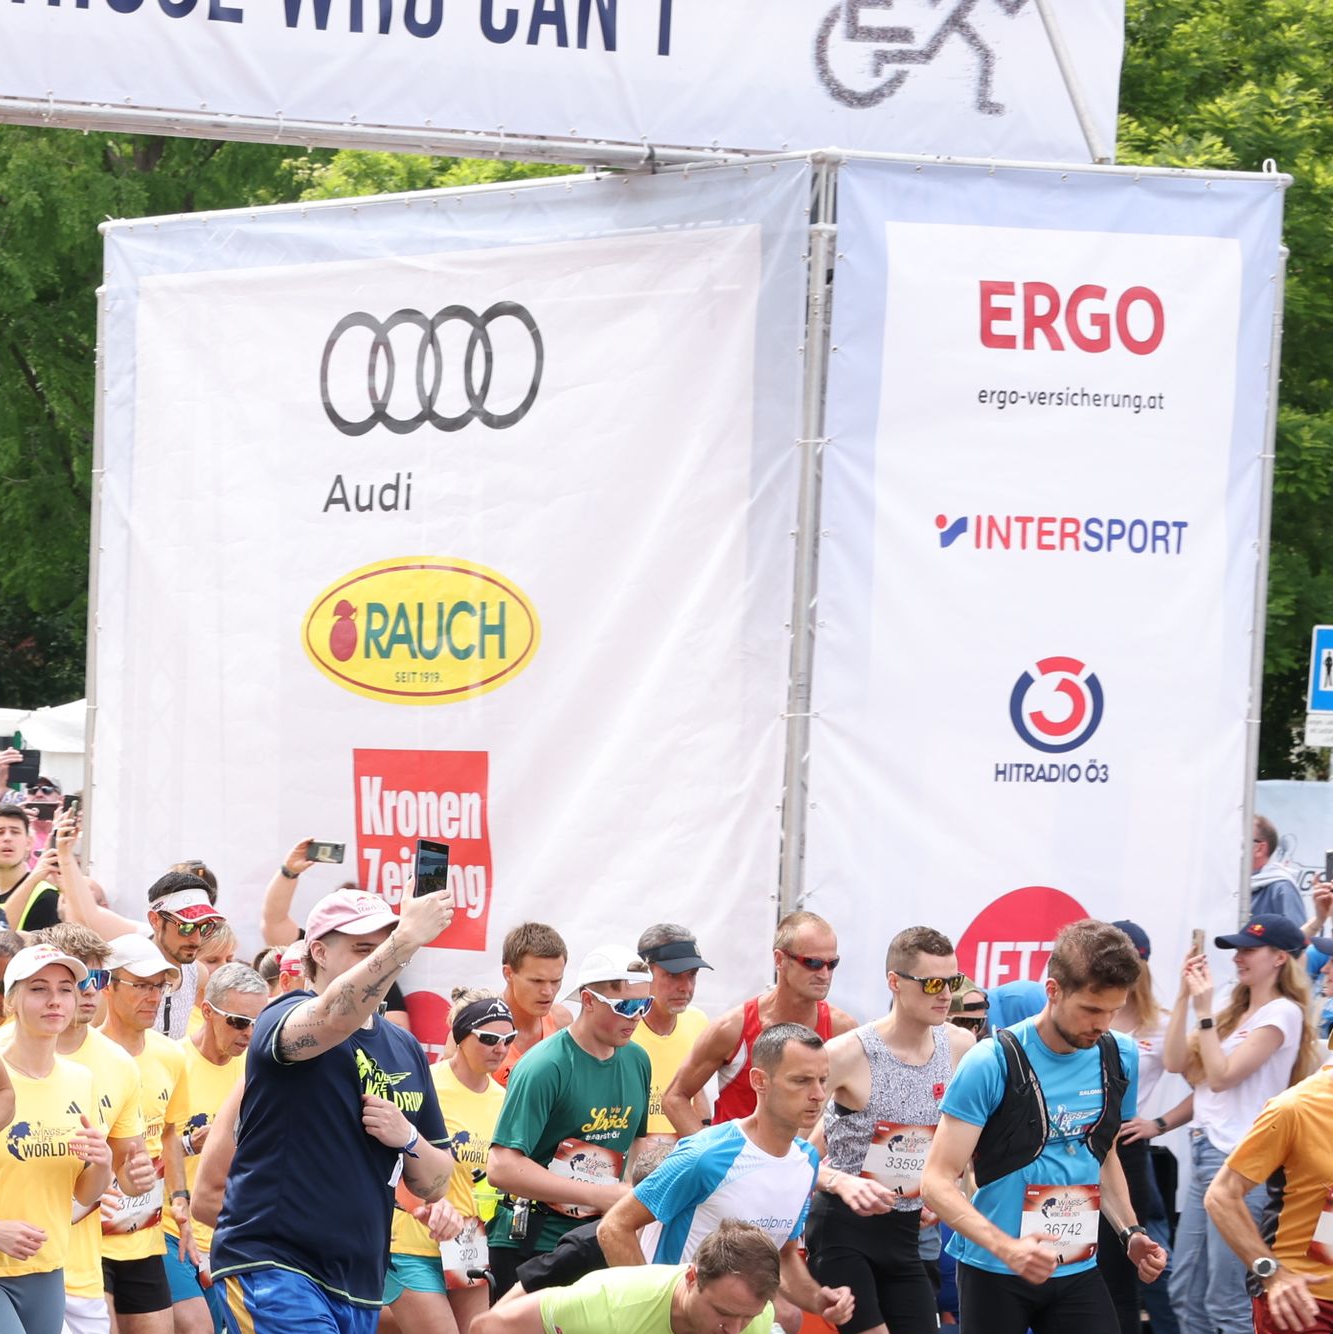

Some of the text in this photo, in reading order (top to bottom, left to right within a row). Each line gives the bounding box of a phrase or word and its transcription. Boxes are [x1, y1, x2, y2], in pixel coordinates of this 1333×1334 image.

[978, 279, 1166, 356] ERGO
[977, 386, 1165, 415] ergo-versicherung.at
[322, 471, 414, 514] Audi
[974, 514, 1189, 555] INTERSPORT
[363, 601, 507, 661] RAUCH
[394, 672, 417, 684] SEIT
[993, 758, 1110, 784] HITRADIO Ö3
[359, 776, 482, 840] Kronen
[362, 846, 486, 919] Zeing
[1078, 1089, 1103, 1097] SALOMO
[649, 1103, 665, 1115] ORL
[22, 1142, 67, 1159] WORLD
[461, 1149, 490, 1165] WORL
[885, 1156, 925, 1171] 33592
[1043, 1222, 1083, 1237] 36742
[1089, 1244, 1096, 1257] 1
